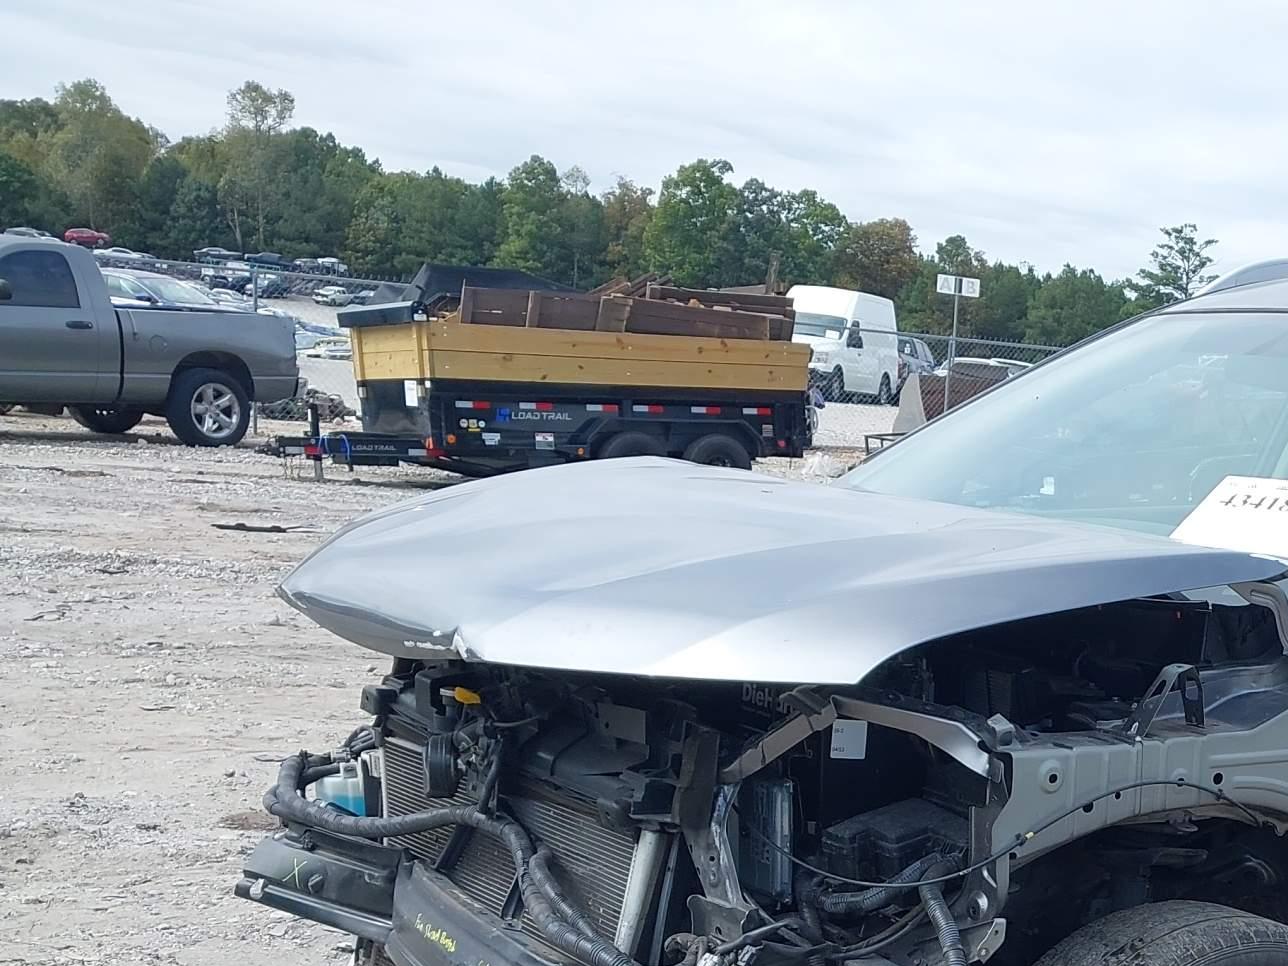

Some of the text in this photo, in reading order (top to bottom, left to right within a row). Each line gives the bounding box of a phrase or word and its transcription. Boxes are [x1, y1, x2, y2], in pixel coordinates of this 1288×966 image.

[939, 276, 977, 294] A B
[511, 411, 573, 421] LOAD TRAIL
